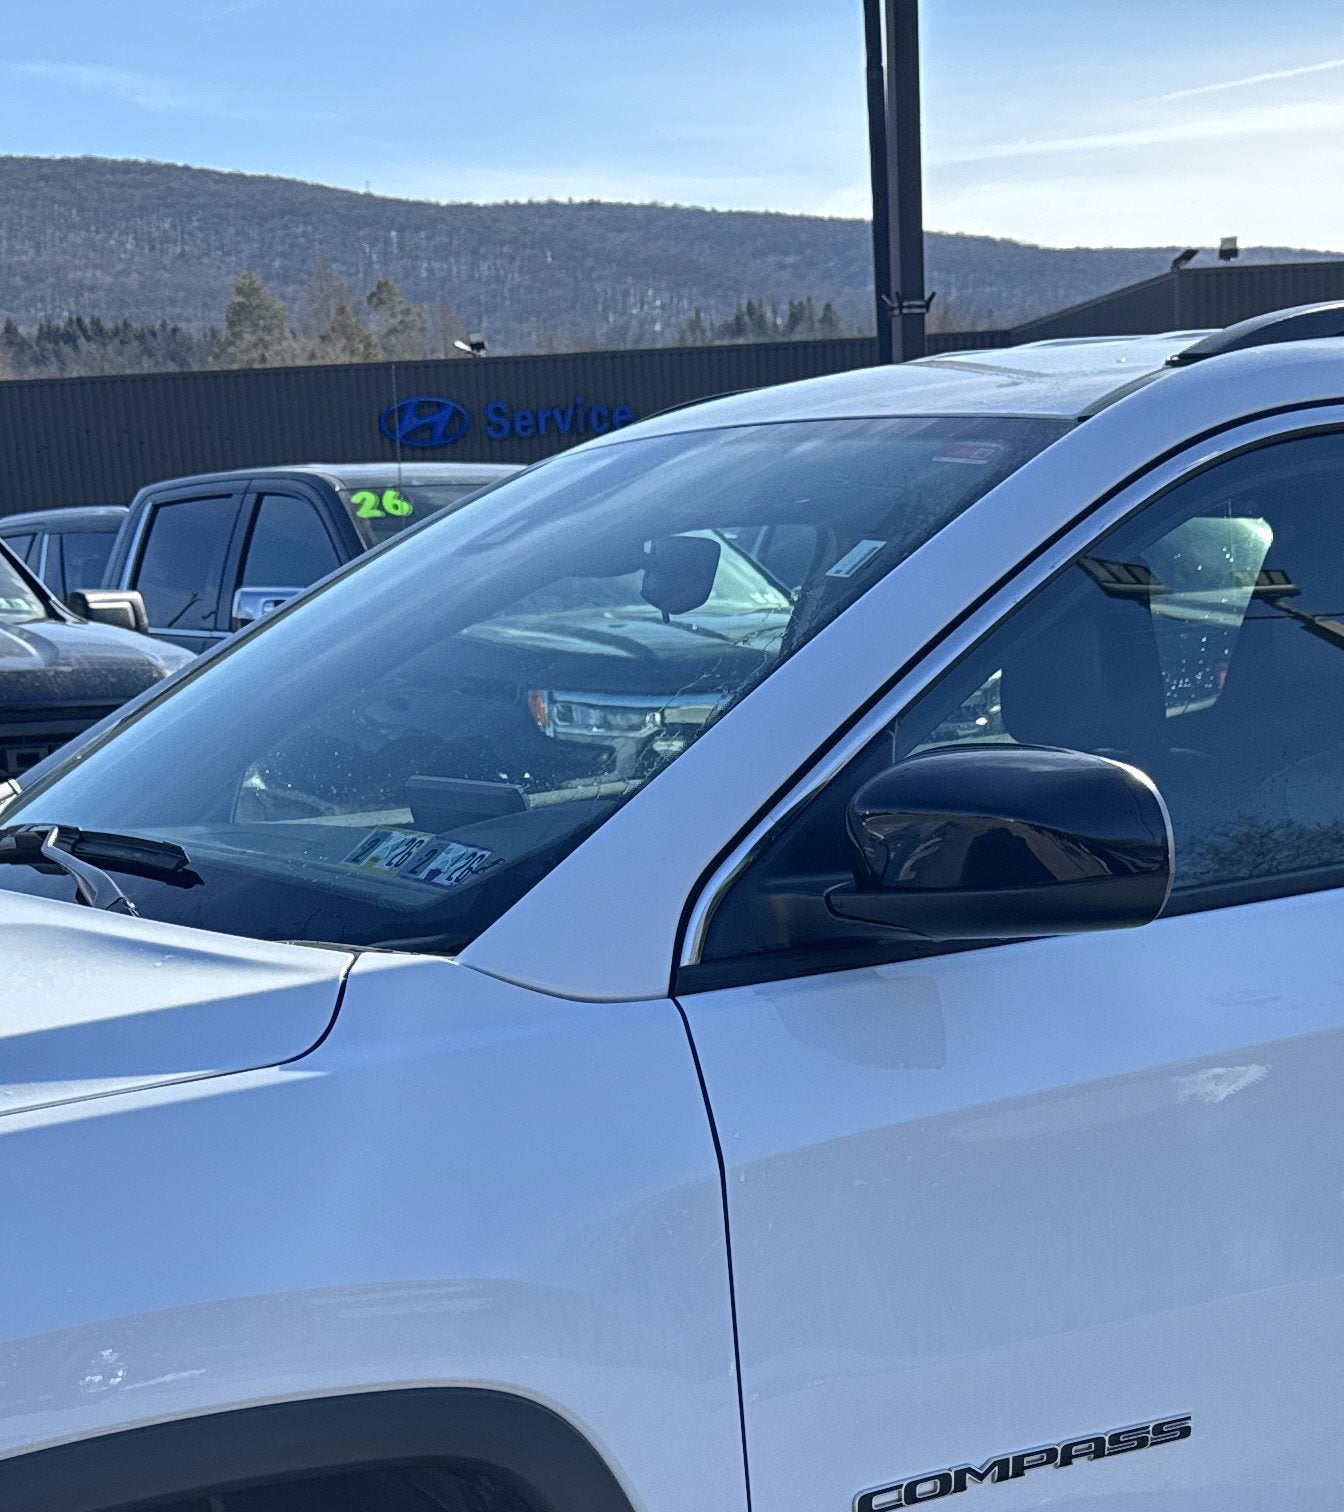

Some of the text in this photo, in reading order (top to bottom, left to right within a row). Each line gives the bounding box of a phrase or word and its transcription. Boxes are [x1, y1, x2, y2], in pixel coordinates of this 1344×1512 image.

[484, 395, 633, 440] Service
[350, 489, 414, 518] 26
[385, 838, 425, 868] 26
[445, 851, 486, 883] 26
